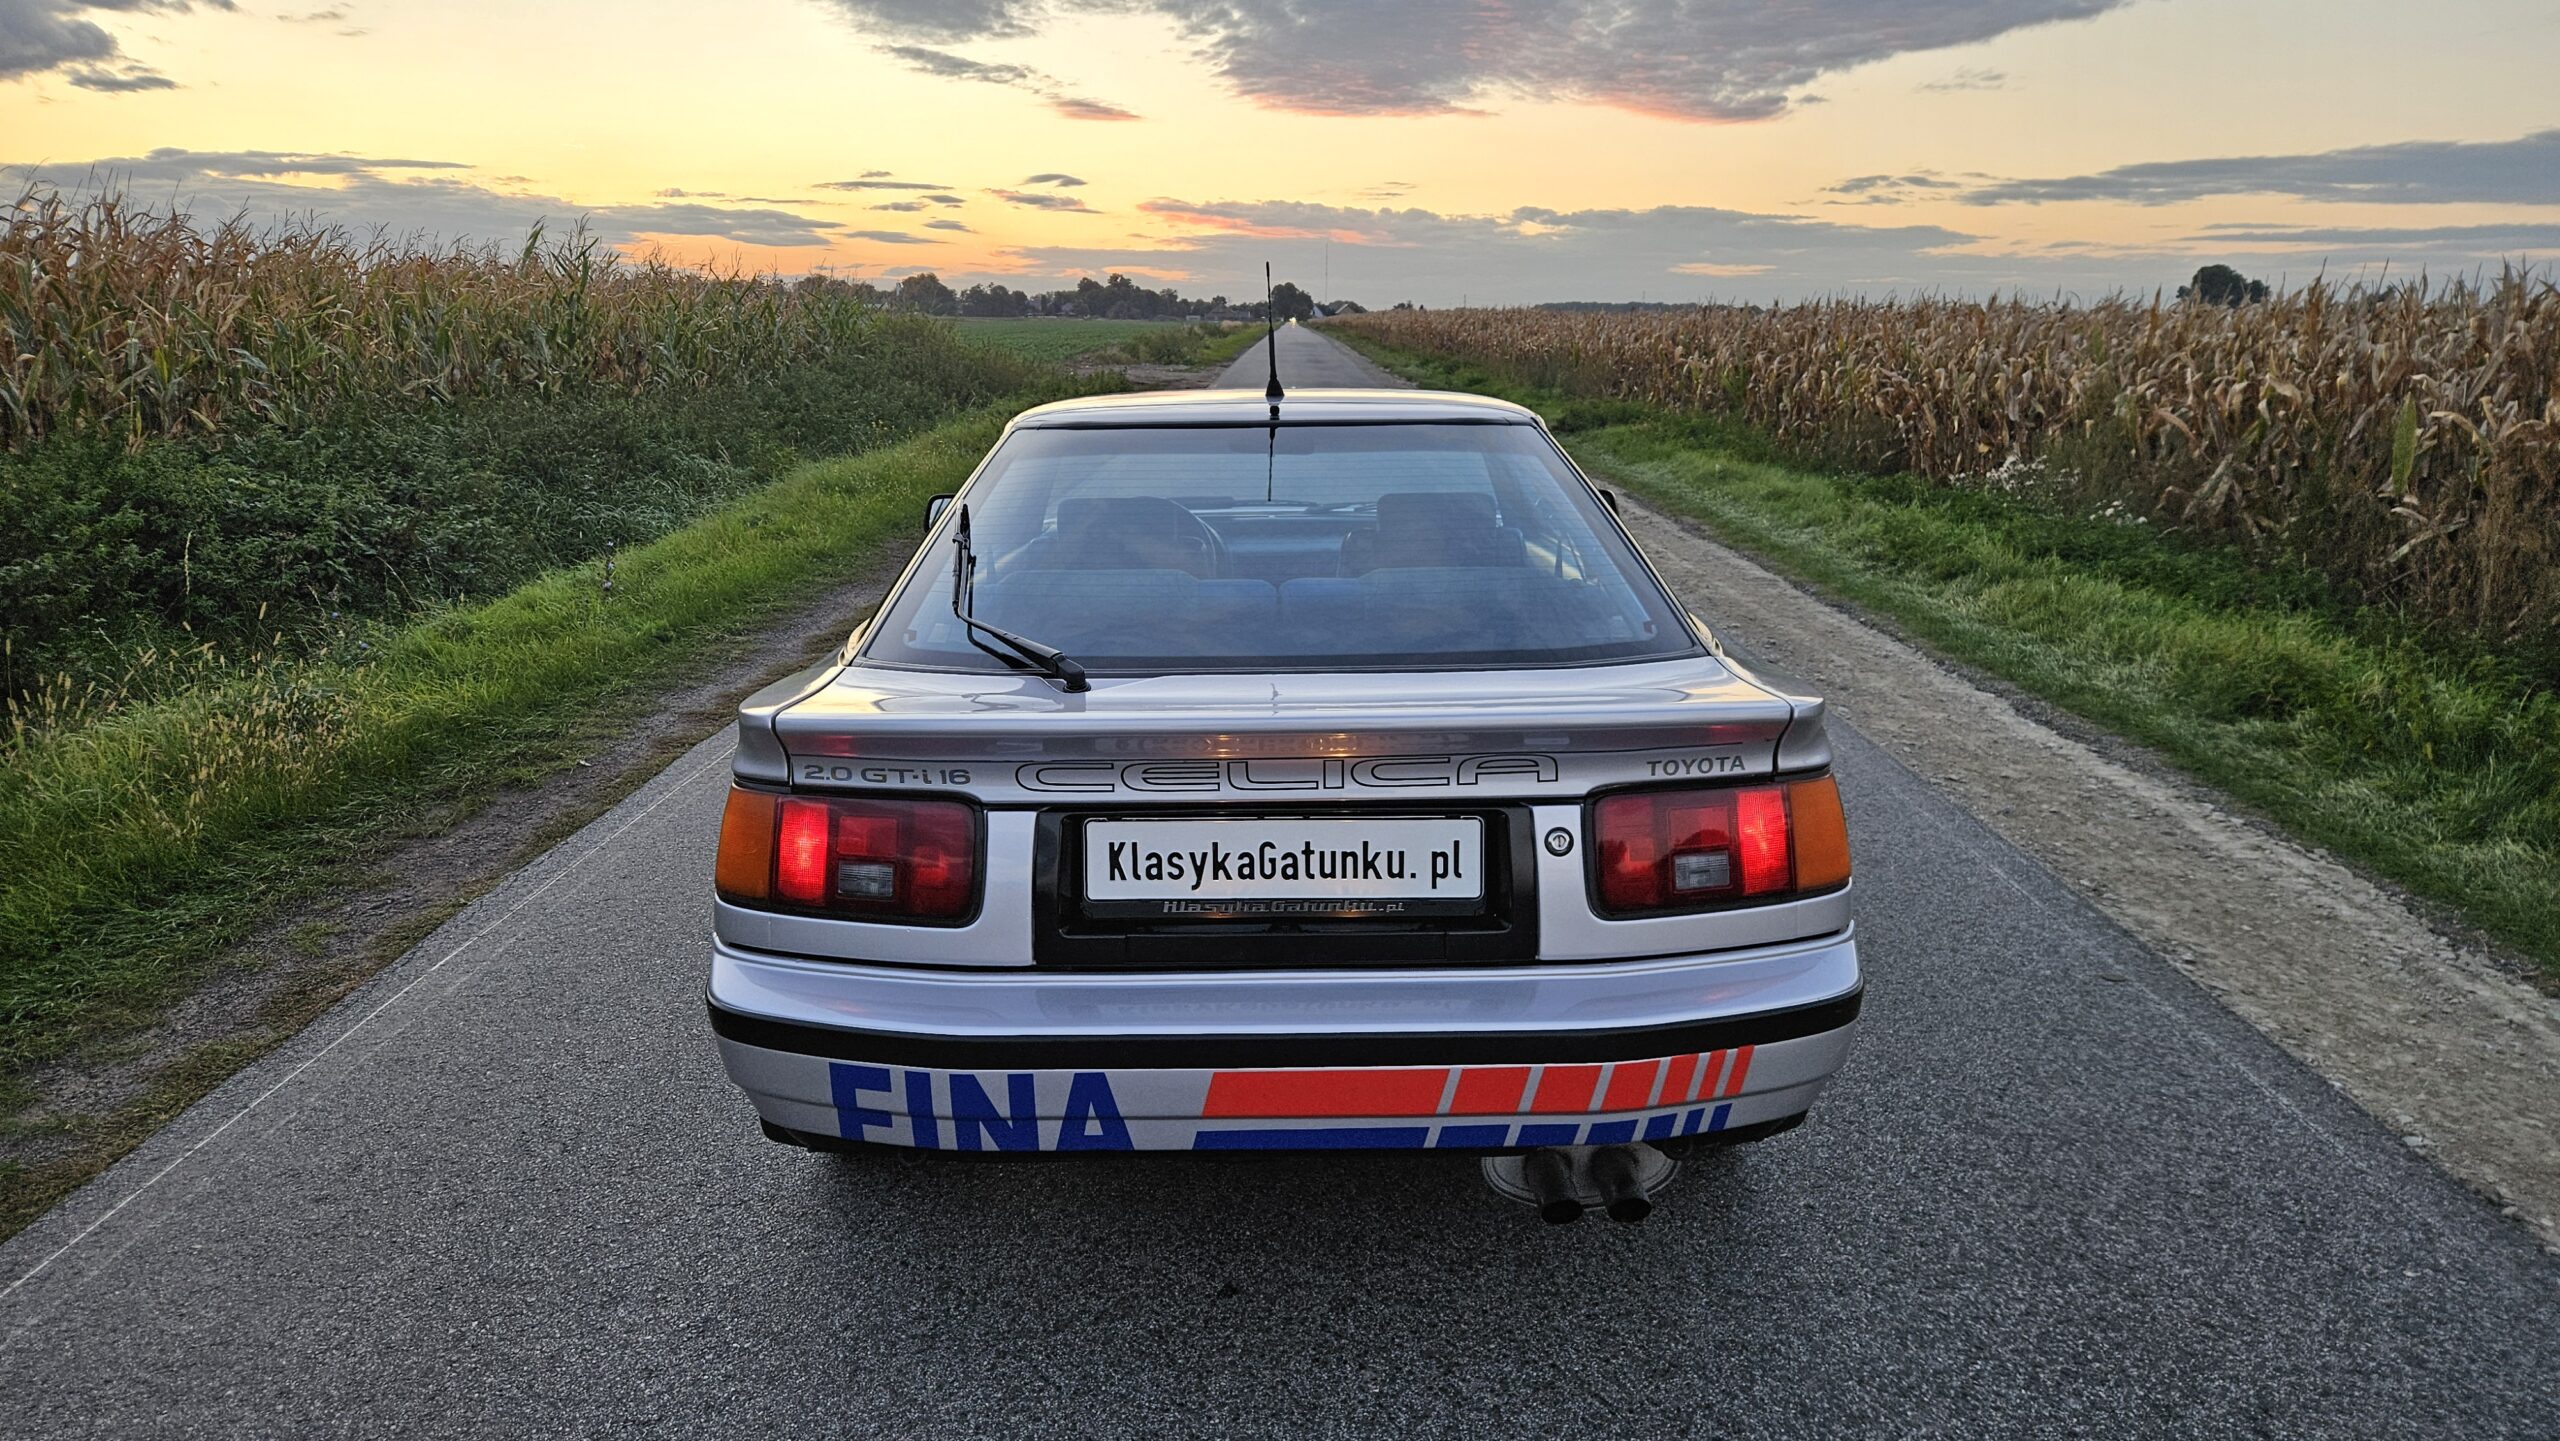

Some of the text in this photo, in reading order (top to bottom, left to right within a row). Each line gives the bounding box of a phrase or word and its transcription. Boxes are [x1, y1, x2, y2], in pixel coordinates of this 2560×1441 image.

[804, 764, 853, 782] 2.0
[939, 769, 971, 785] 16
[1015, 753, 1559, 793] CELICA
[1646, 755, 1747, 777] TOYOTA
[828, 1061, 1136, 1152] FINA
